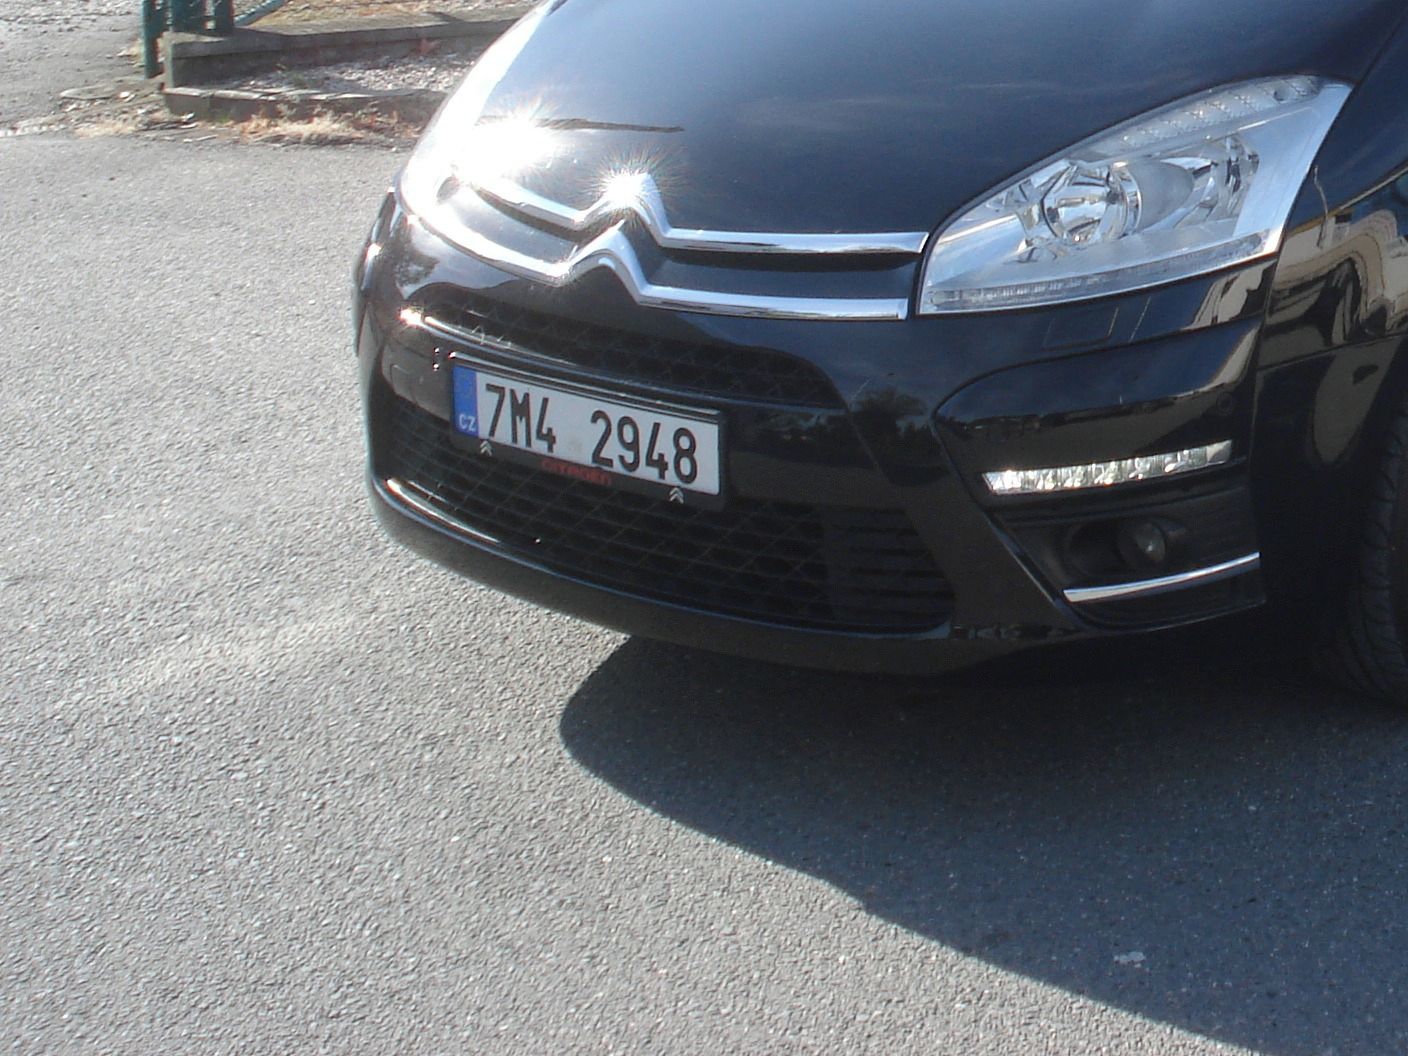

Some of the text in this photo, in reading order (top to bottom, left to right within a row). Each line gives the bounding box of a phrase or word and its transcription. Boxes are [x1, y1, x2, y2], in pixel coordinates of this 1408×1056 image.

[458, 413, 477, 433] CZ
[485, 383, 698, 485] 7M4 2948
